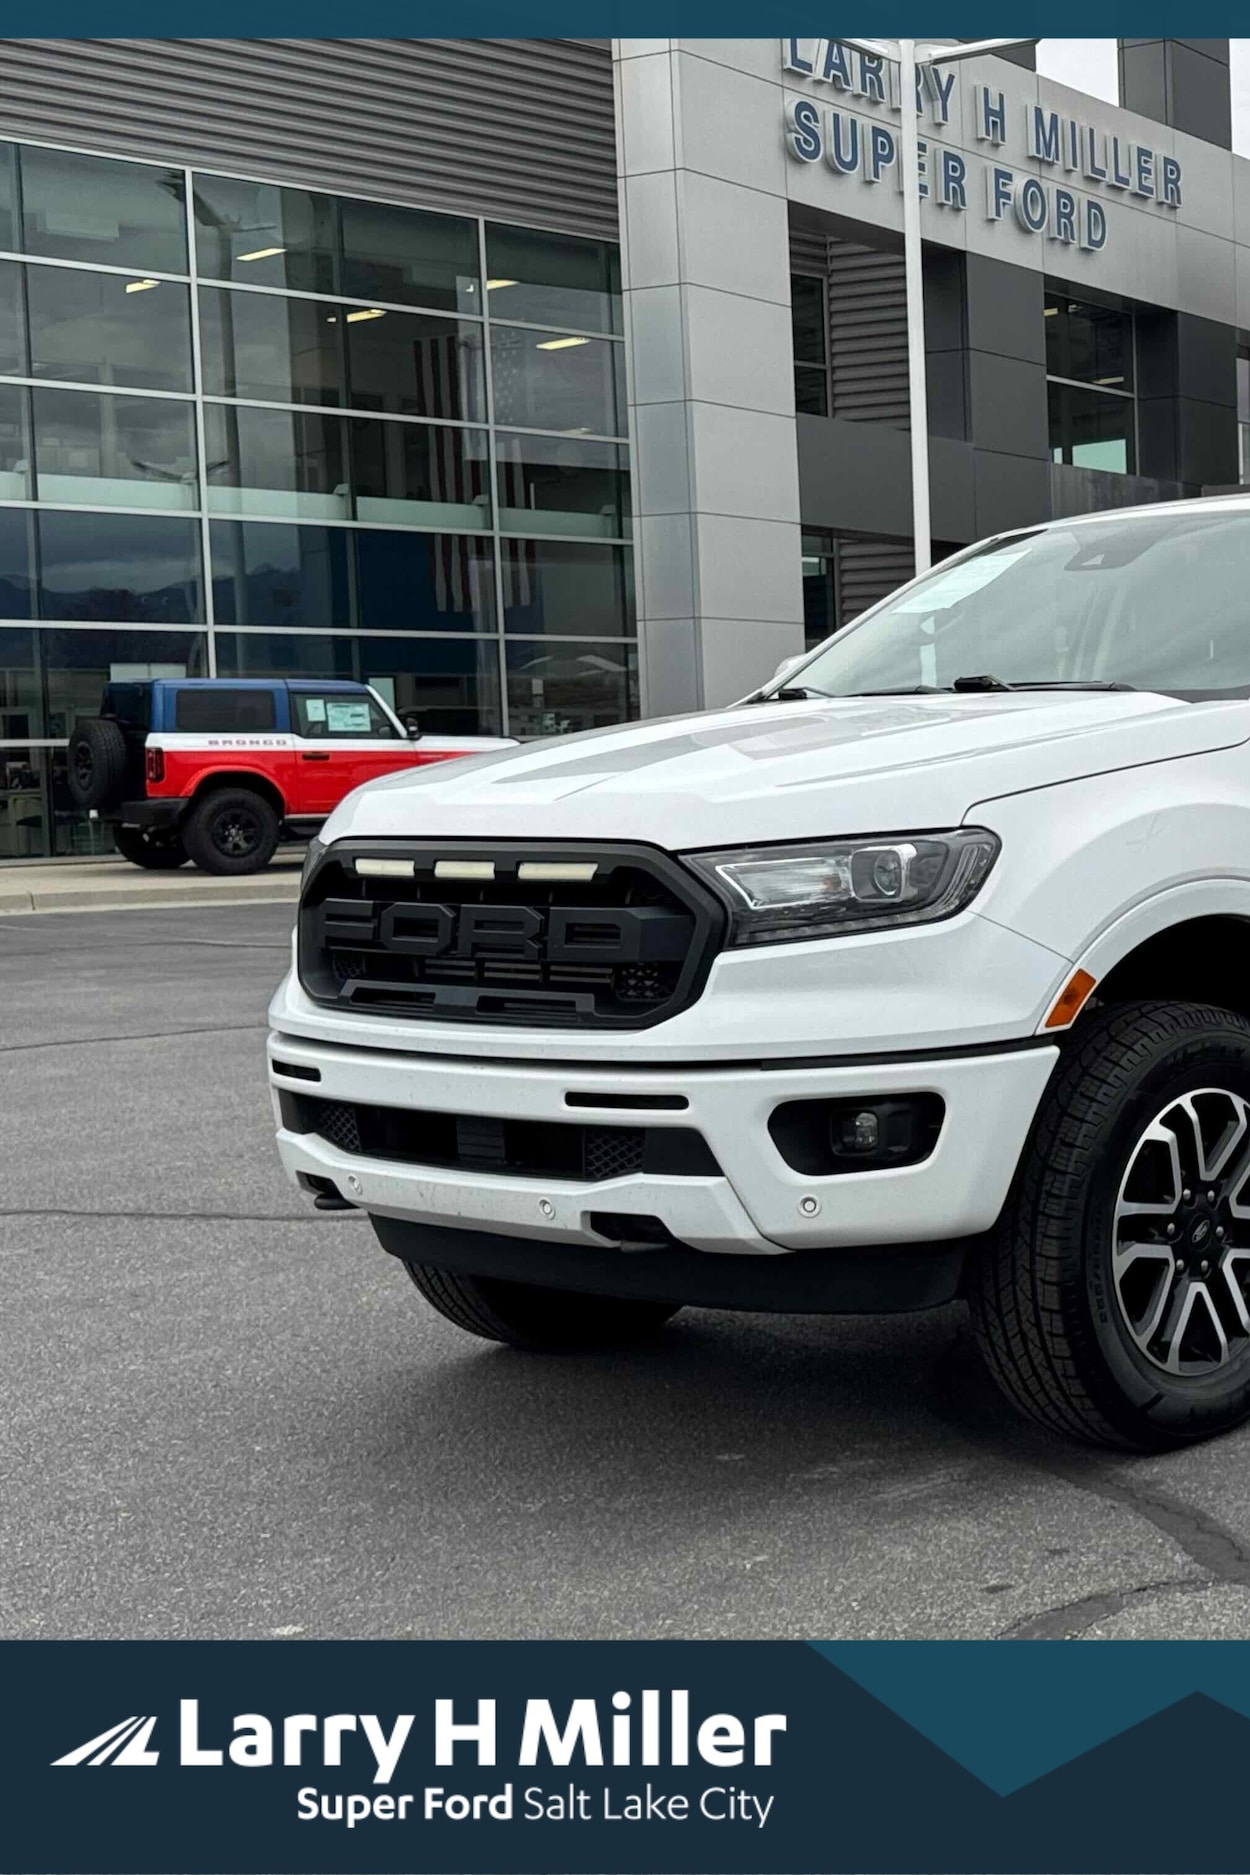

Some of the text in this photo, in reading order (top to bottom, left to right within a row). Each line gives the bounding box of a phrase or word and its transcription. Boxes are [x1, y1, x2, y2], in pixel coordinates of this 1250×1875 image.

[979, 84, 1006, 145] H
[1029, 103, 1183, 207] MILLER
[989, 165, 1108, 251] FORD
[320, 898, 642, 961] FORD
